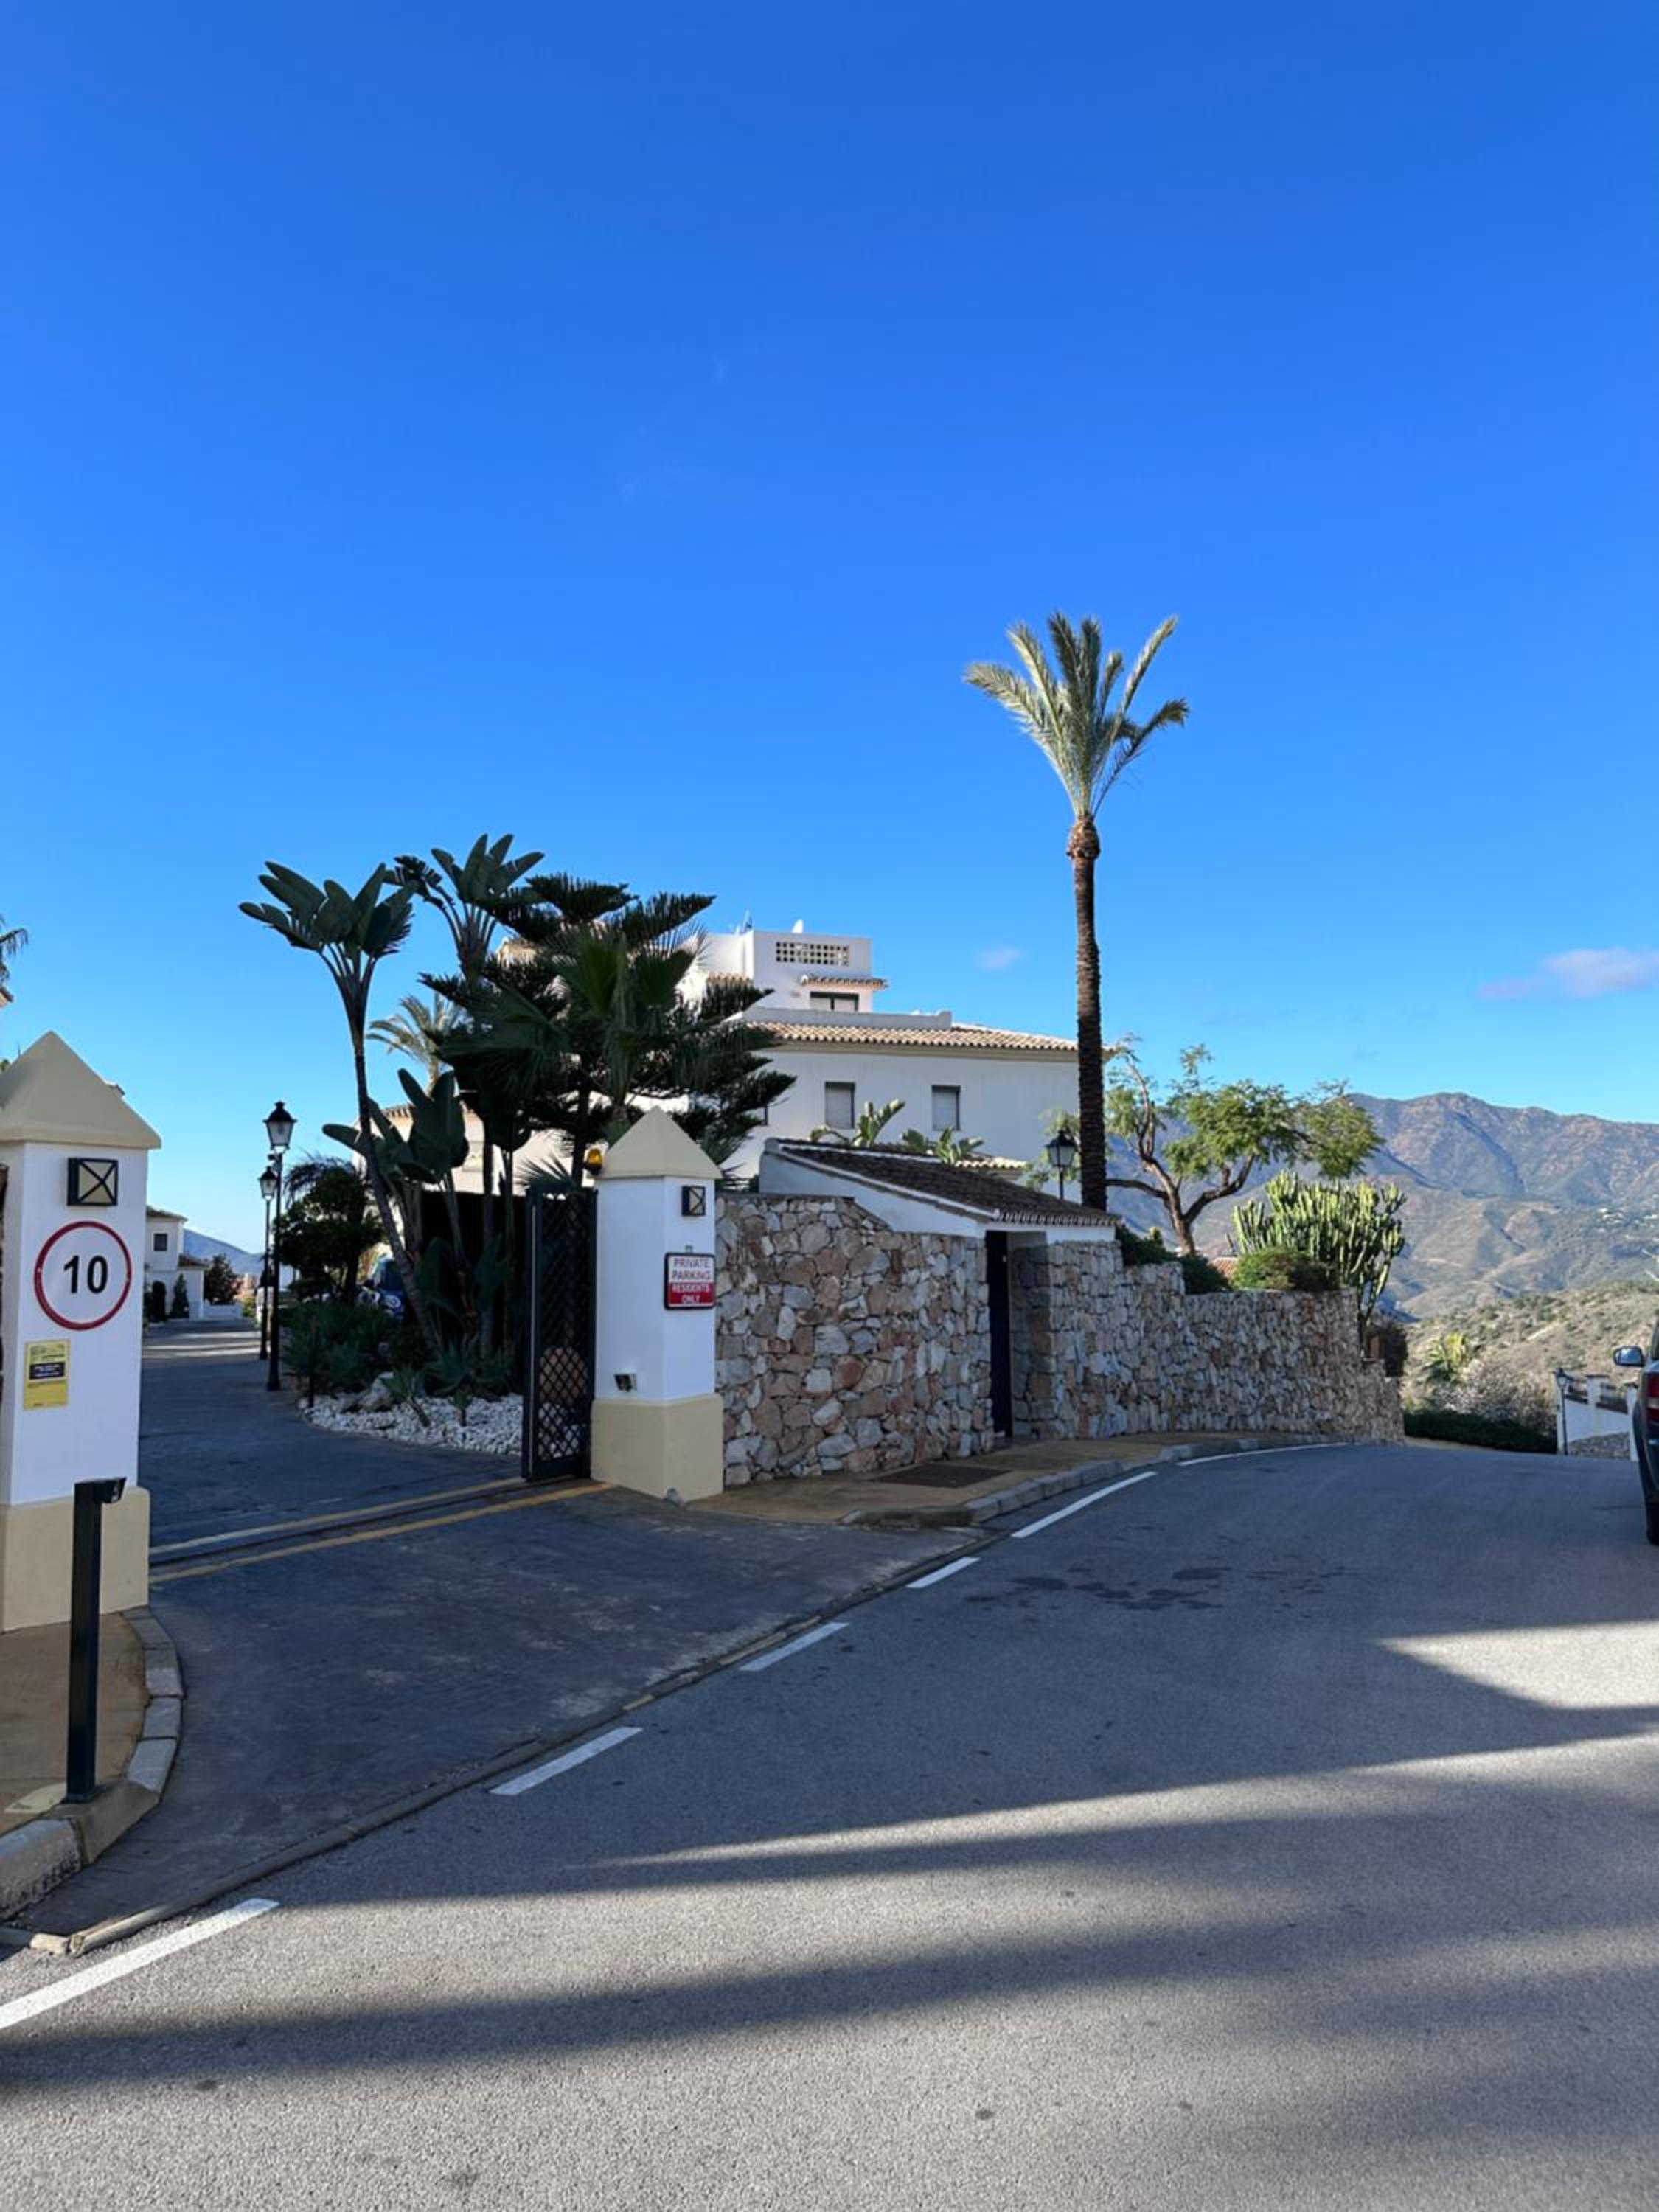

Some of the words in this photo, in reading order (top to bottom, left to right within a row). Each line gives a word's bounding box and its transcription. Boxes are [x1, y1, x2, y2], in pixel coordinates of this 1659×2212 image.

[673, 1257, 710, 1267] PRIVATE
[63, 1256, 108, 1293] 10
[672, 1270, 710, 1279] PARKING
